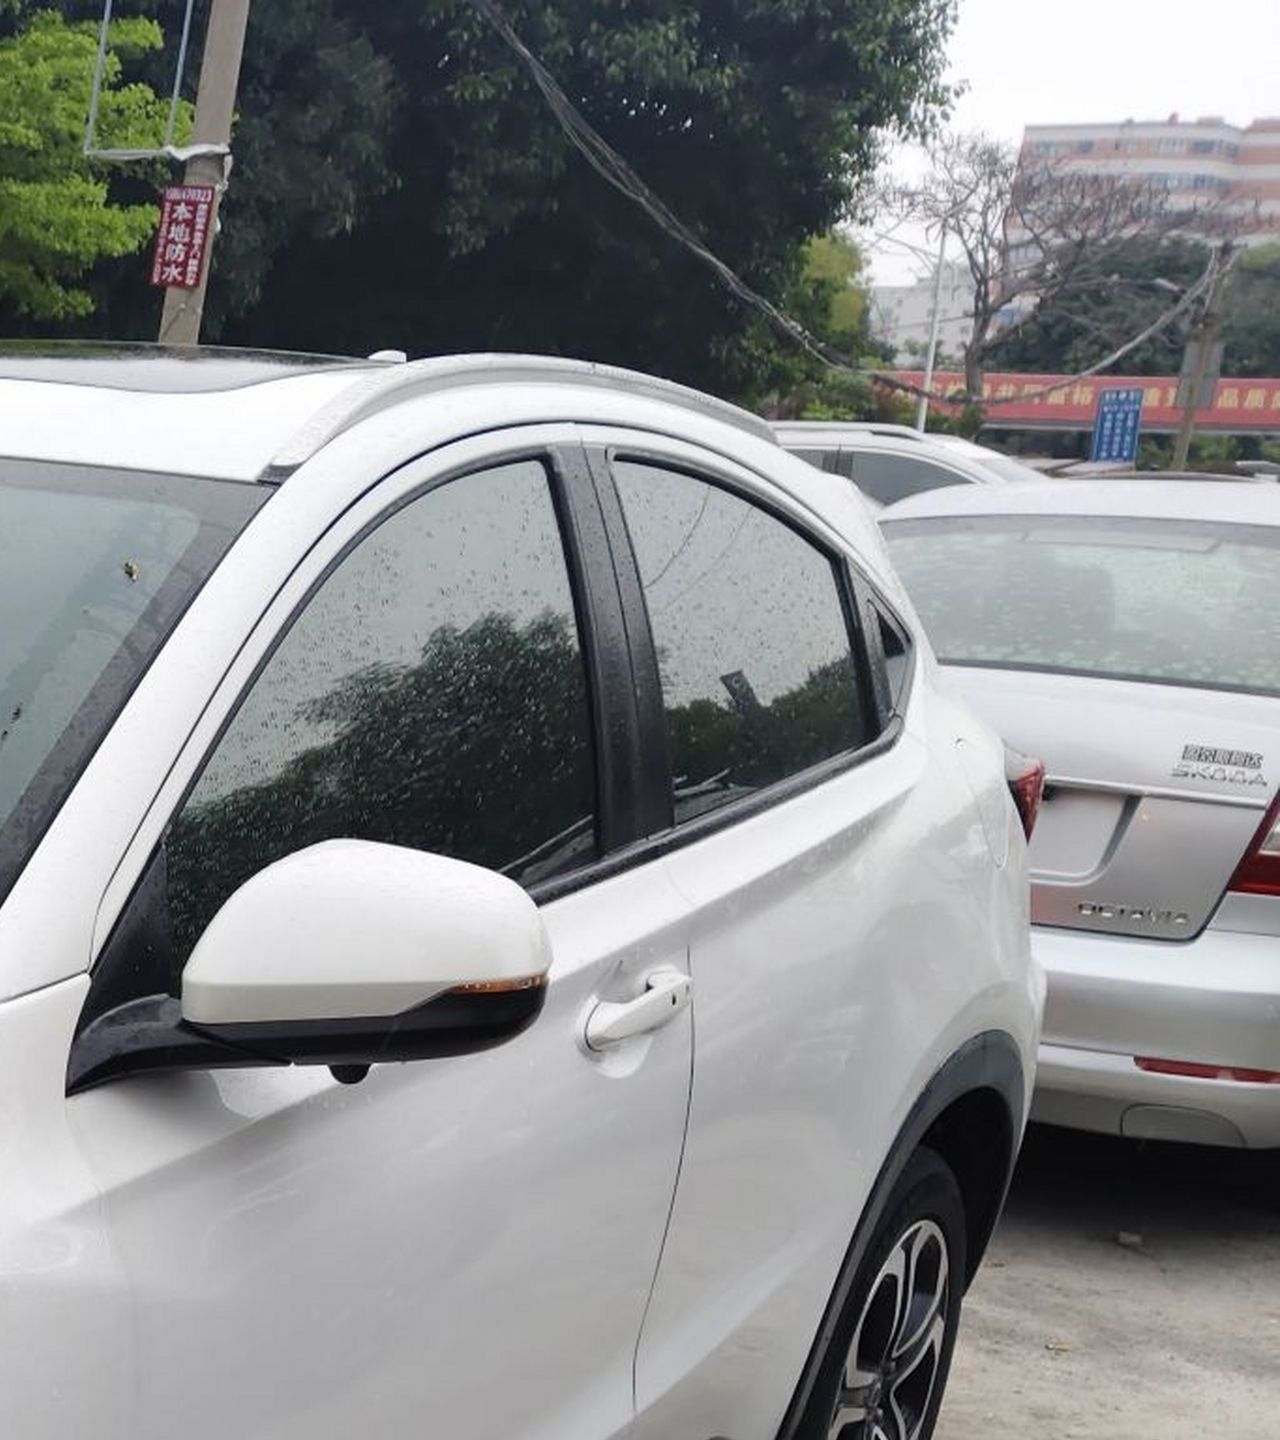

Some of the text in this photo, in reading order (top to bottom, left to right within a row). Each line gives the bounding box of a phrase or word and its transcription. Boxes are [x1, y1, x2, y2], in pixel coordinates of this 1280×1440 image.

[161, 202, 194, 282] 本地防水
[1077, 902, 1189, 923] OCTAVIA
